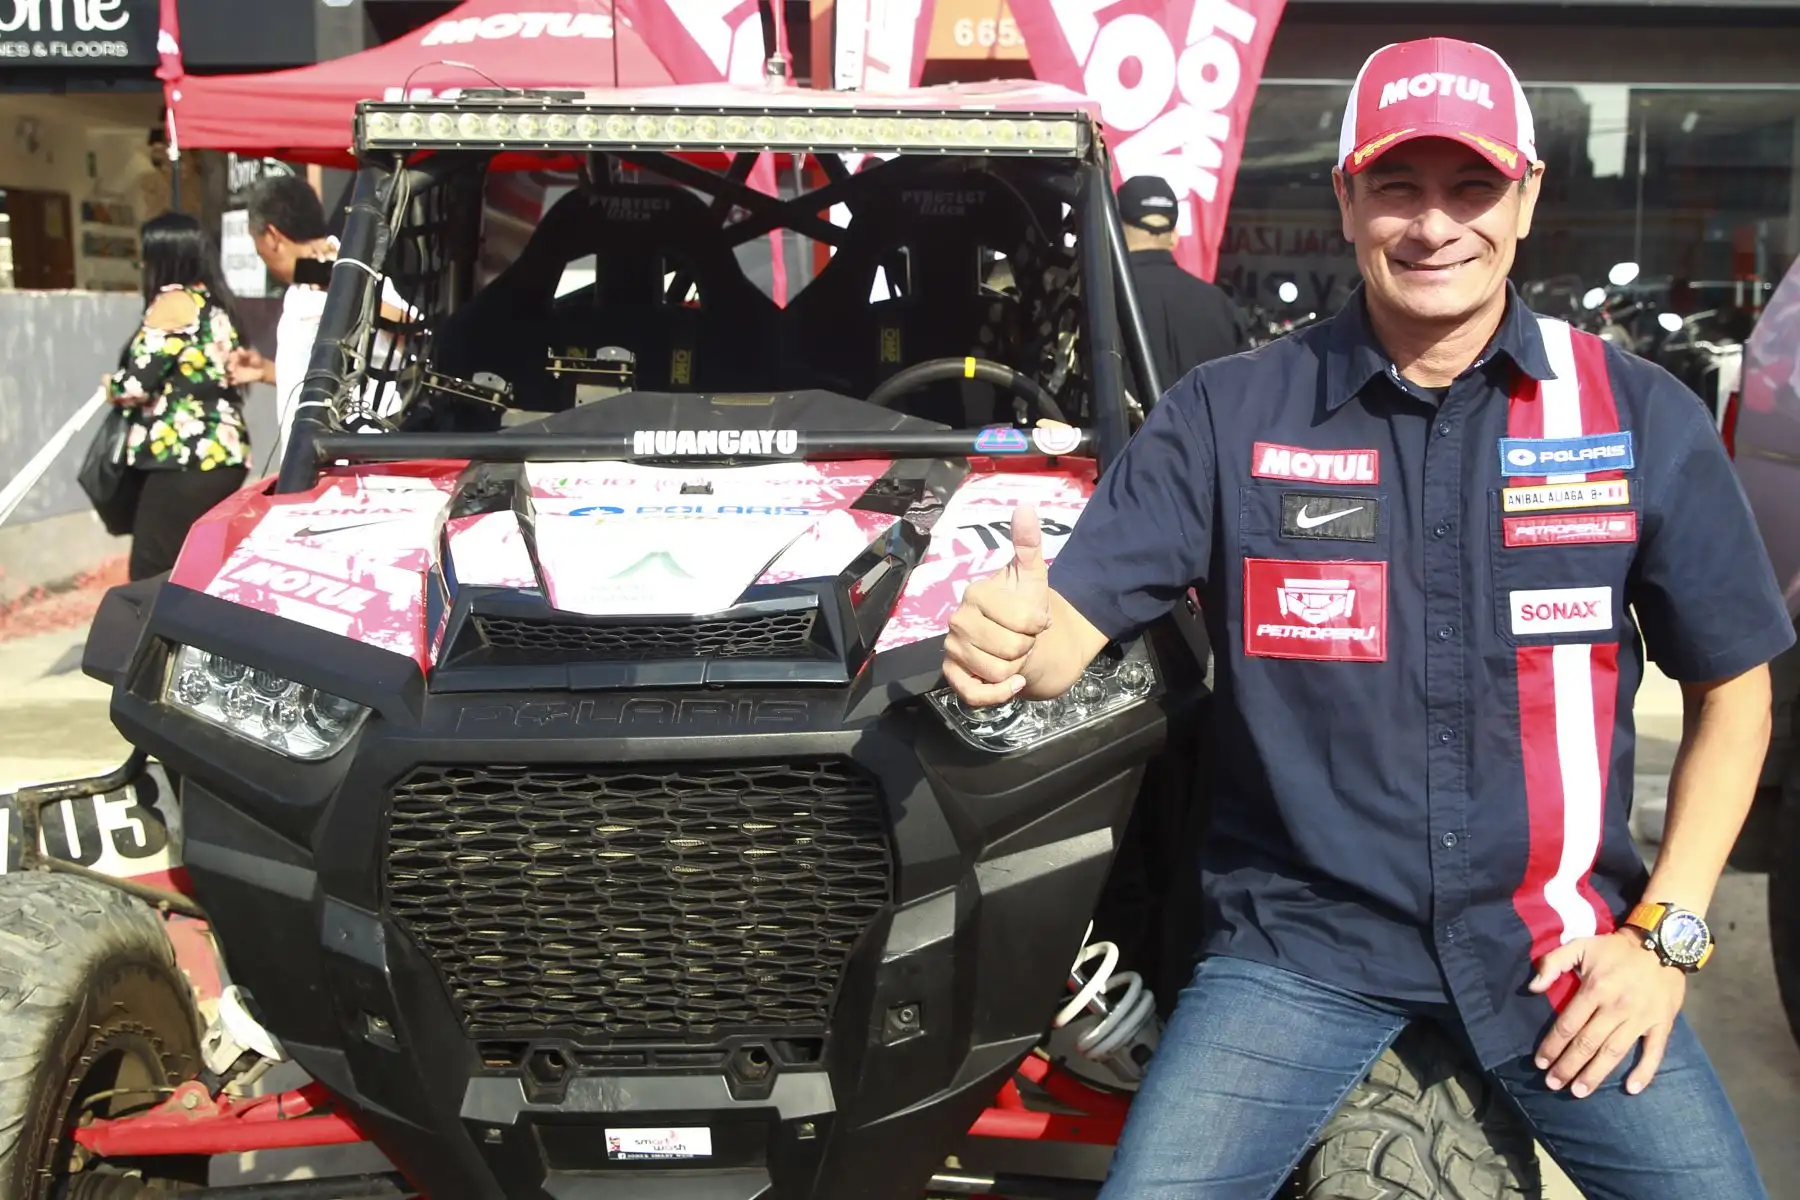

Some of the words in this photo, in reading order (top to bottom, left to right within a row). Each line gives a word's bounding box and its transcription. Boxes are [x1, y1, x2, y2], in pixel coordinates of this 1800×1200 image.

[421, 12, 614, 46] MOTUL
[953, 17, 1026, 48] 665
[32, 41, 48, 57] &
[50, 41, 129, 57] FLOORS
[1378, 72, 1495, 110] MOTUL
[633, 430, 798, 455] HUANCAYO
[1539, 445, 1626, 463] POLARIS
[1259, 448, 1374, 481] MOTUL
[635, 505, 811, 516] POLARIS
[1508, 493, 1544, 505] ANIBAL
[1548, 490, 1584, 501] ALIAGA
[227, 561, 378, 613] MOTUL
[1520, 600, 1600, 621] SONAX
[455, 697, 809, 732] POLARIS
